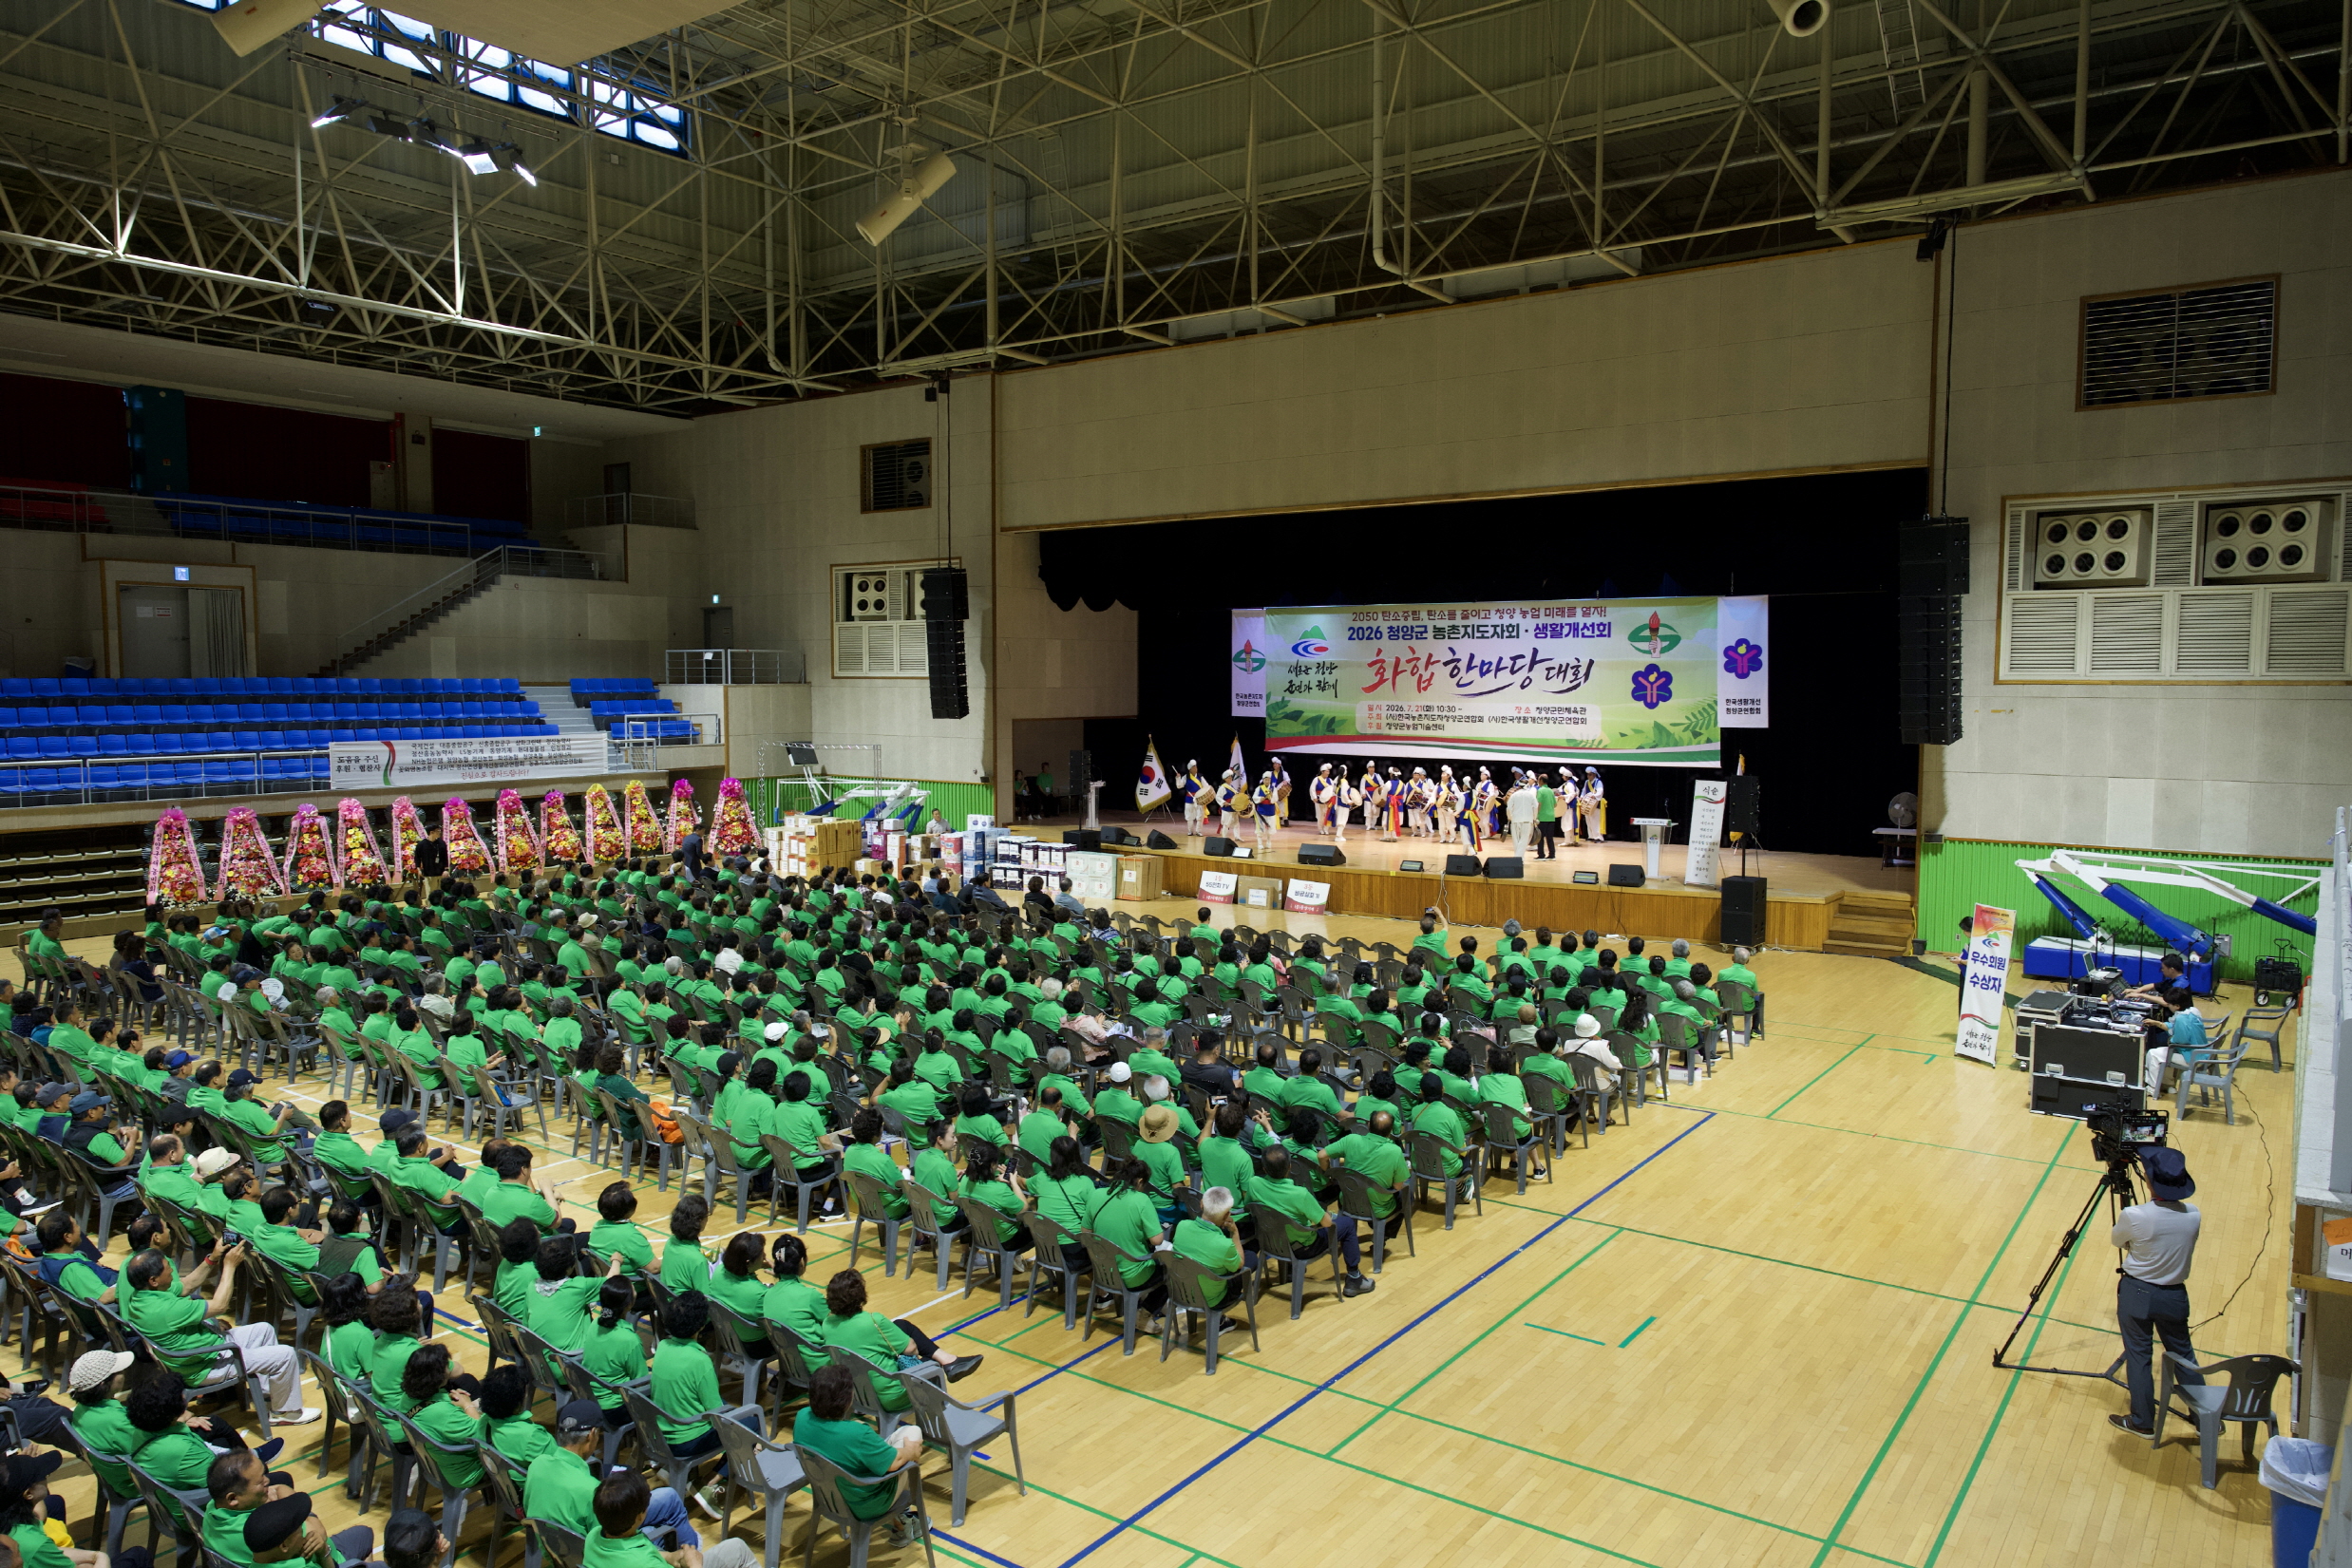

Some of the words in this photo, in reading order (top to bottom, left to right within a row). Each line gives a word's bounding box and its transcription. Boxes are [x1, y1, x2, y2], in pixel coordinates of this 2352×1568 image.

[1352, 612, 1378, 622] 2050
[1381, 611, 1424, 622] 탄소중립,
[1427, 609, 1457, 621] 탄소를
[1460, 609, 1491, 620] 줄이고
[1494, 608, 1516, 619] 청양
[1519, 608, 1541, 618] 농업
[1544, 607, 1577, 618] 미래를
[1581, 606, 1607, 617] 열자!
[1347, 626, 1383, 641] 2026
[1387, 625, 1429, 640] 청양군
[1432, 623, 1520, 639] 농촌지도자회
[1533, 622, 1612, 639] 생활개선회
[1315, 660, 1338, 675] 청양
[1360, 646, 1441, 696] 화합
[1442, 646, 1555, 698] 한마당
[1544, 657, 1595, 693] 대회
[1535, 707, 1587, 715] 청양군민체육관
[1385, 723, 1445, 731] 청양군농업기술센터
[364, 754, 379, 764] 주신
[1702, 785, 1718, 796] 식순
[1970, 951, 2006, 971] 우수회원
[1969, 972, 2002, 993] 수상자
